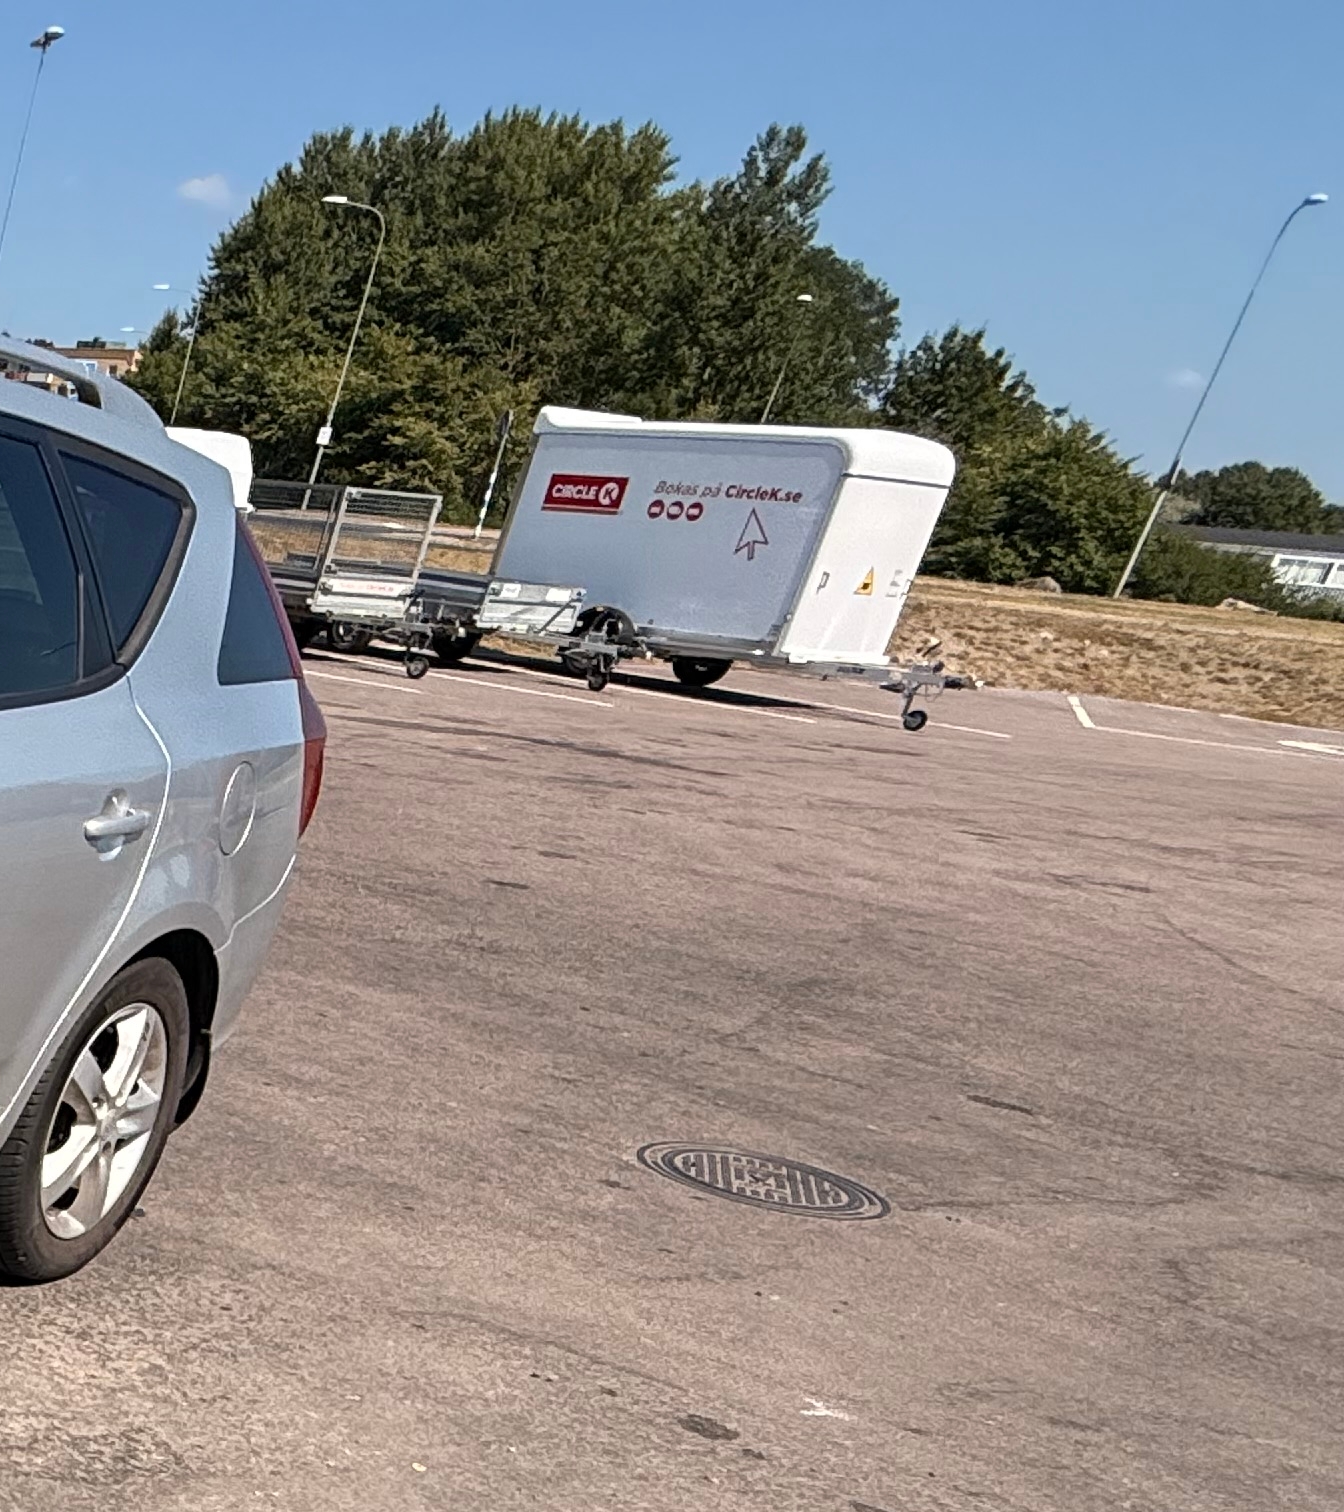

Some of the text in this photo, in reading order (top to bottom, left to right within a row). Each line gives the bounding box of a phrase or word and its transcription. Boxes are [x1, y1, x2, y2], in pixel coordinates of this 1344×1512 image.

[552, 483, 599, 499] CIRCLE
[653, 480, 803, 503] Bokas på CircleK.se
